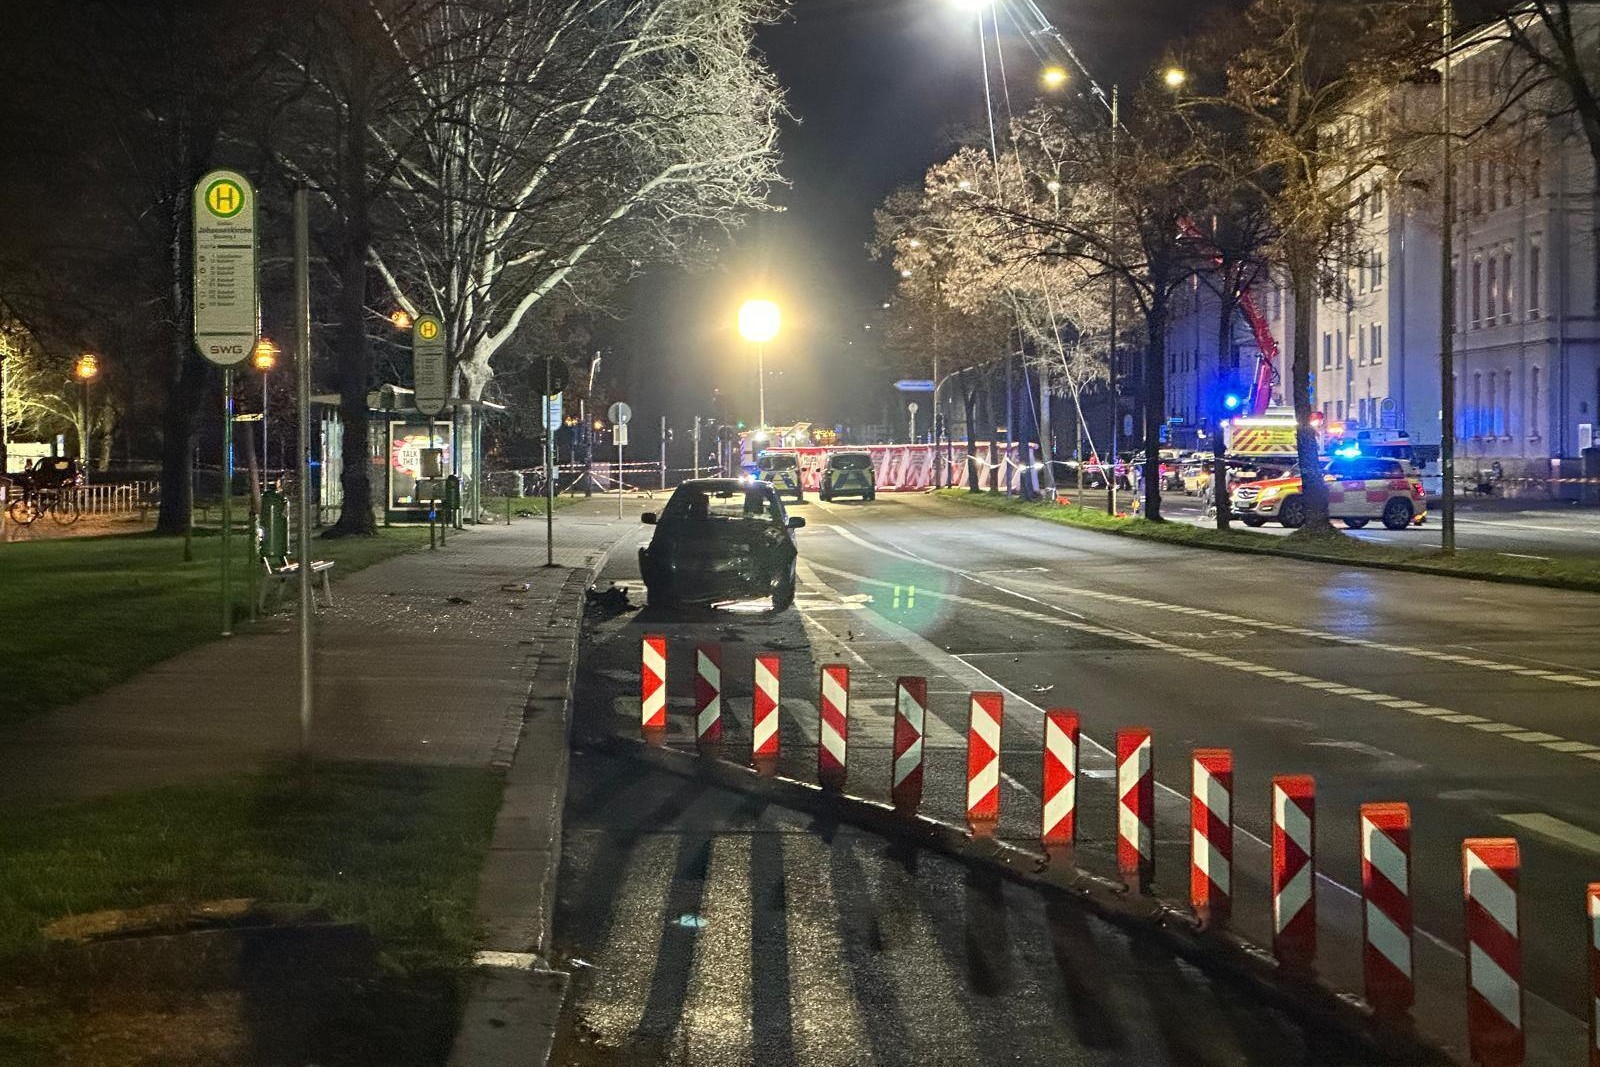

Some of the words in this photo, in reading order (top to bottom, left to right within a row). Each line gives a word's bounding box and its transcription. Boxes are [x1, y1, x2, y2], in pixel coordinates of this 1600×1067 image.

[216, 187, 234, 210] H
[424, 324, 433, 336] H
[210, 345, 243, 354] SWG
